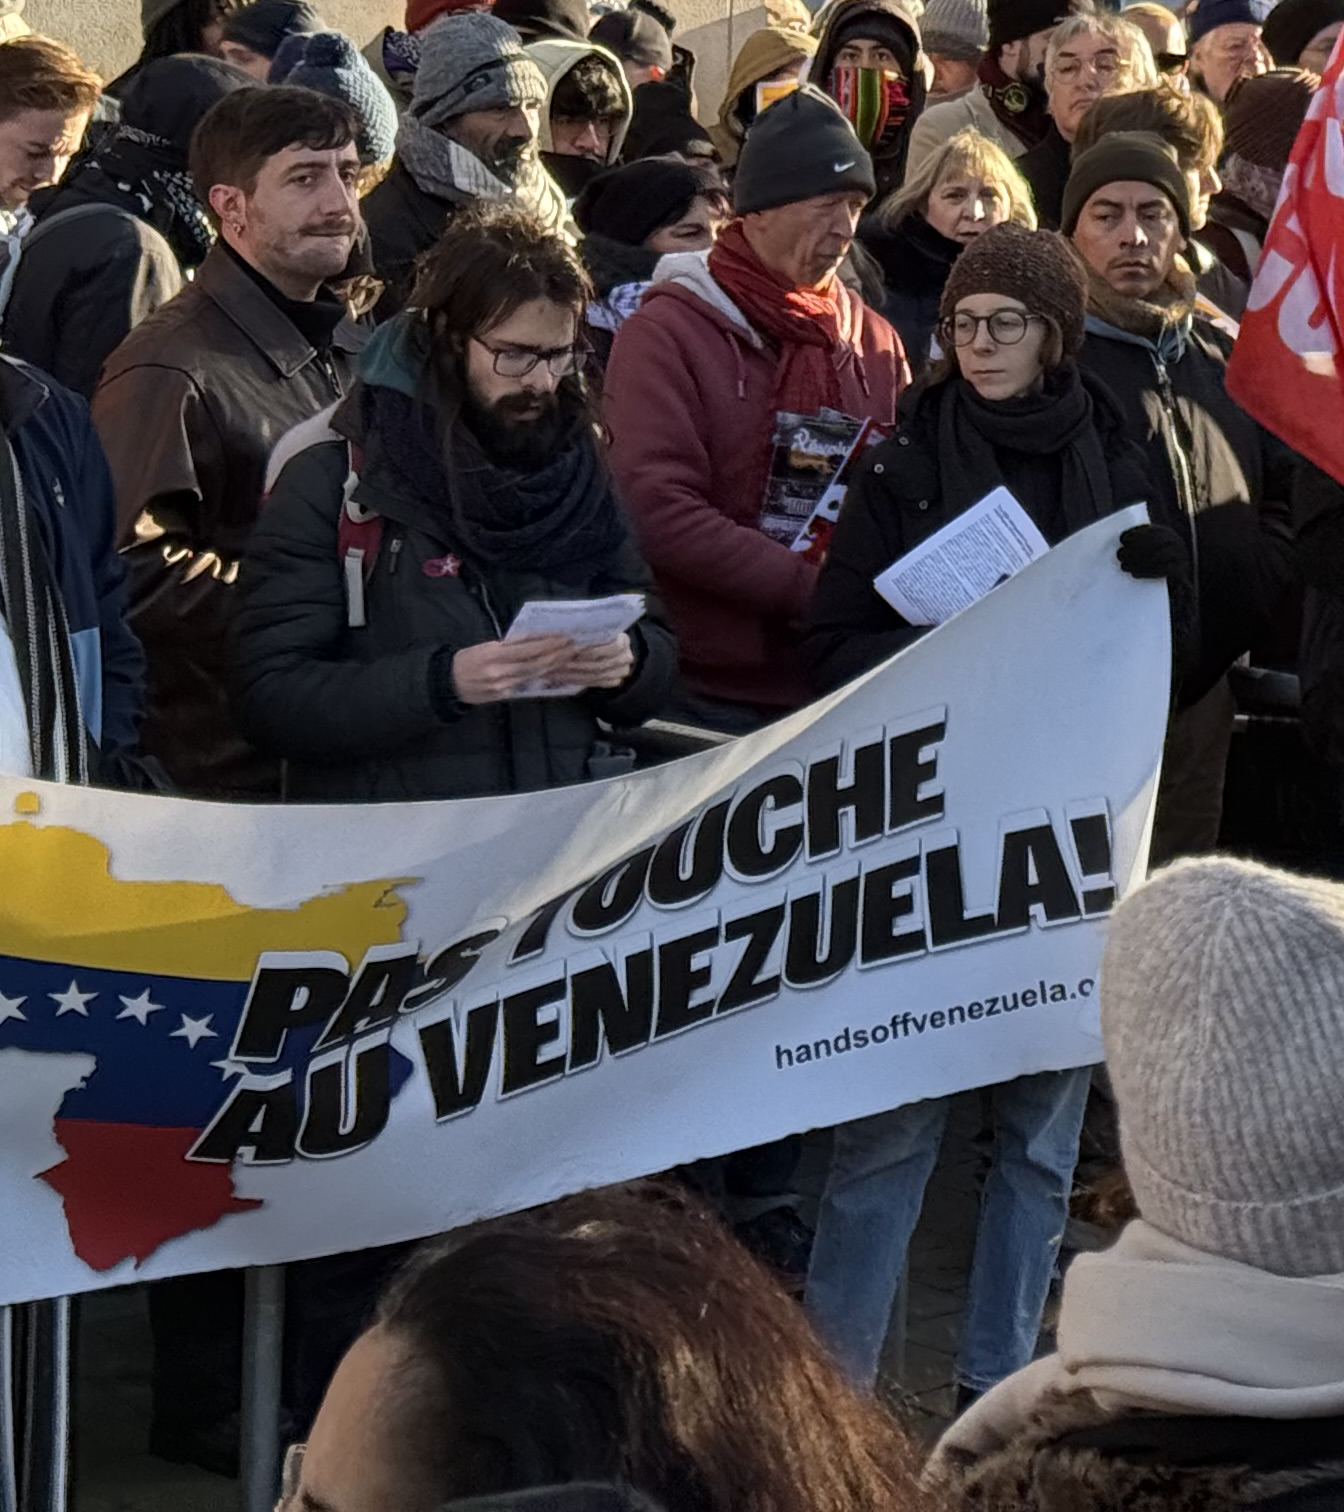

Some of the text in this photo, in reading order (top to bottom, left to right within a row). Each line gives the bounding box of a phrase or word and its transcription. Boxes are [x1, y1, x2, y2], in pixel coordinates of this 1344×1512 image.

[184, 796, 1118, 1165] AU VENEZUELA!
[228, 916, 511, 1064] PAS
[775, 977, 1096, 1071] handsoffvenezuela.o
